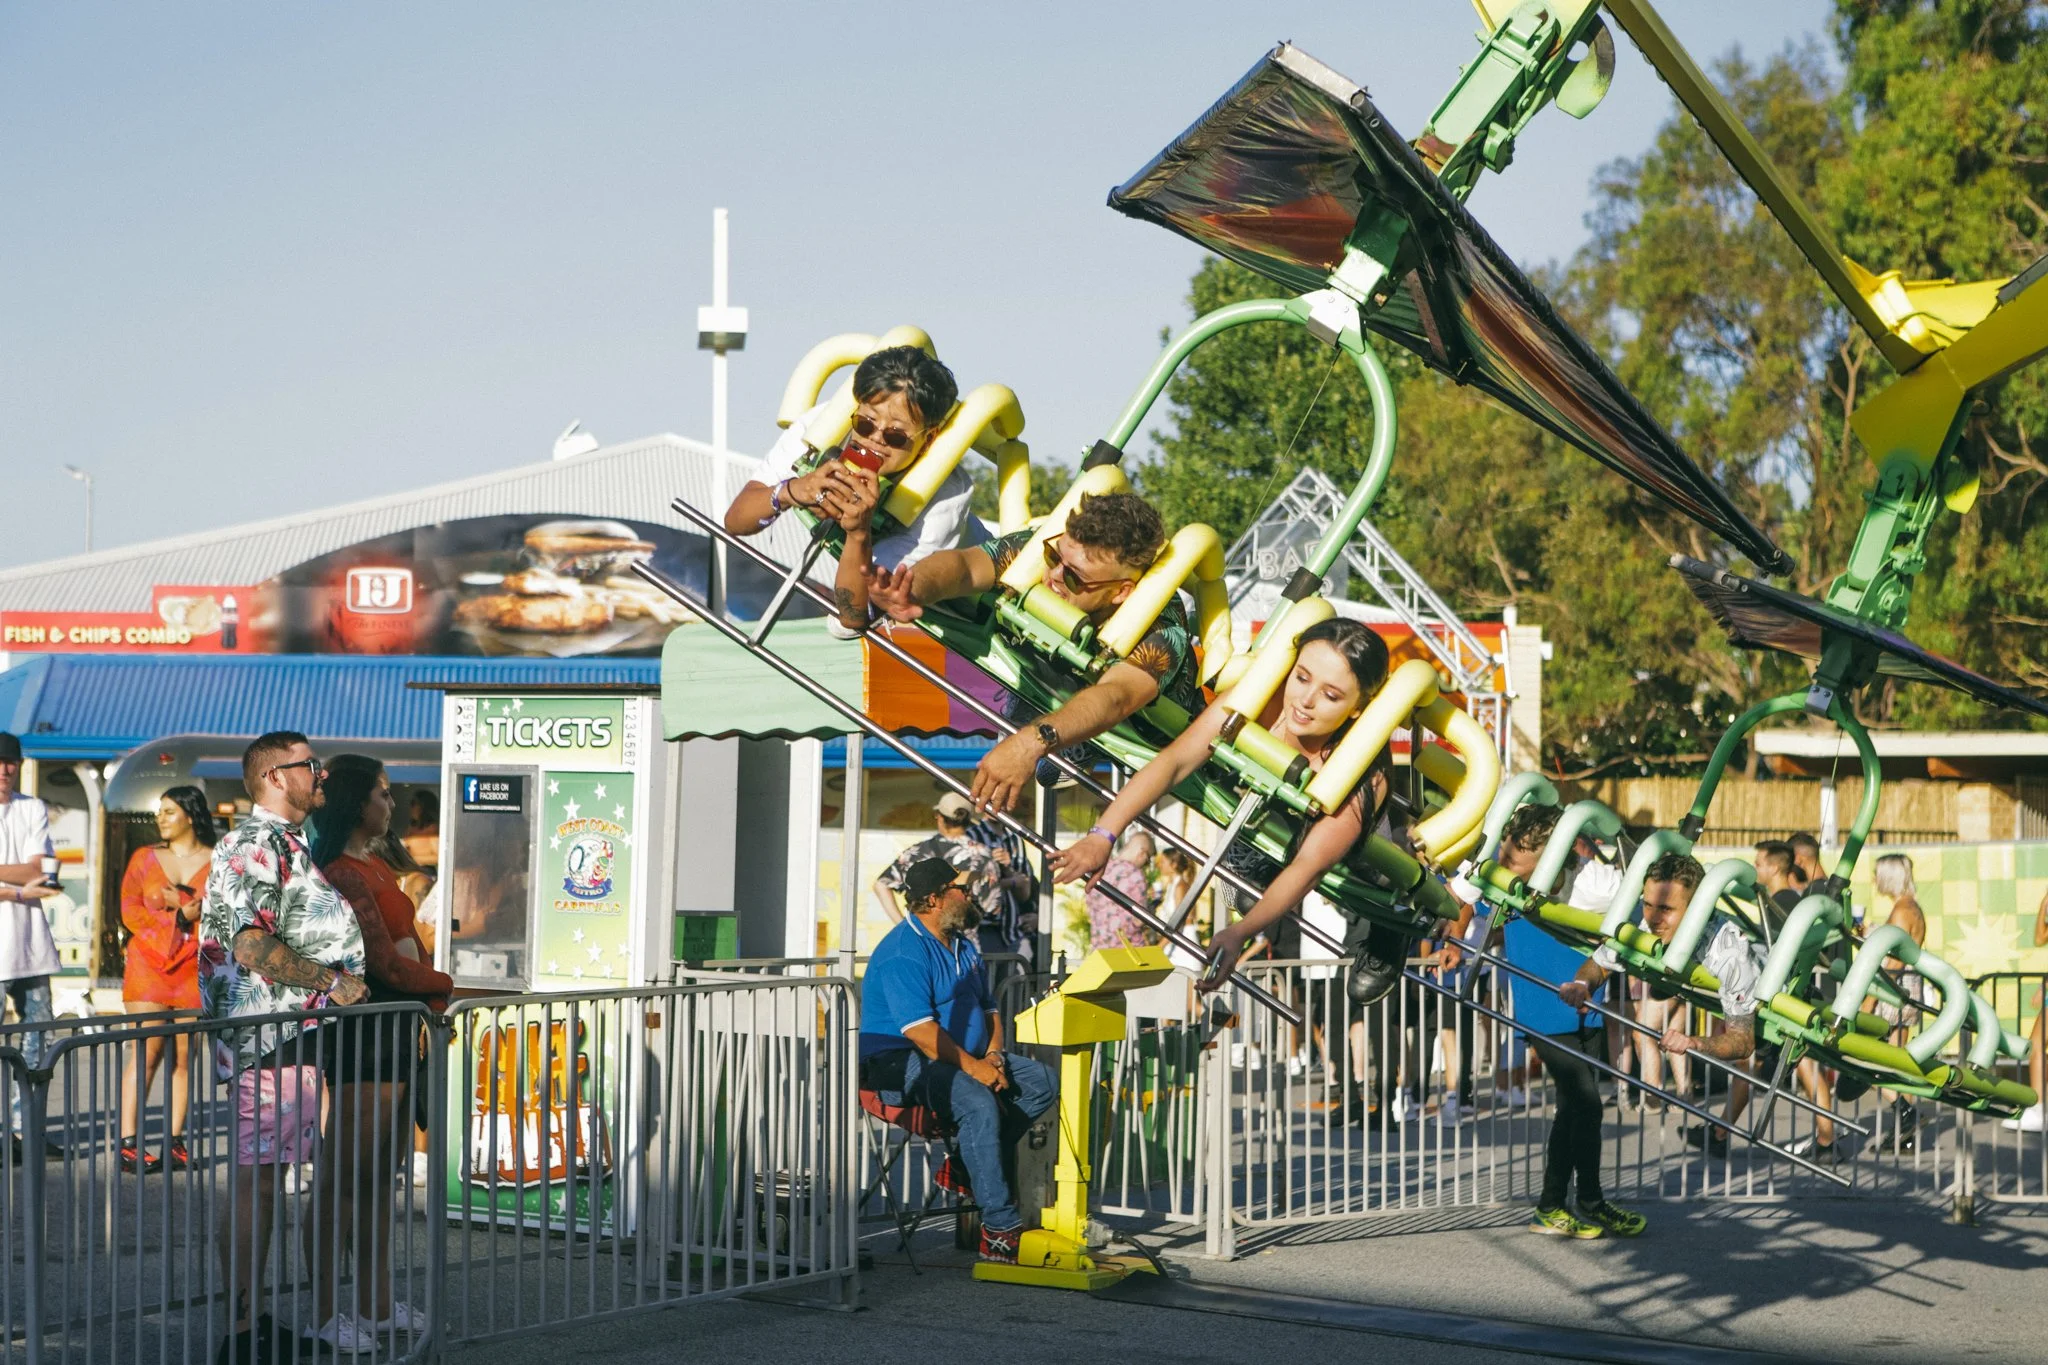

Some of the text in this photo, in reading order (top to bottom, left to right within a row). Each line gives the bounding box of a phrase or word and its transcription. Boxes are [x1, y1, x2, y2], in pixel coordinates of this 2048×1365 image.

[4, 626, 192, 644] FISH & CHIPS COMBO
[486, 716, 613, 748] TICKETS
[479, 783, 510, 792] LIKE US ON
[479, 791, 510, 801] FACEBOOK!
[557, 818, 626, 839] WEST COAST
[554, 900, 622, 914] CARNIVALS
